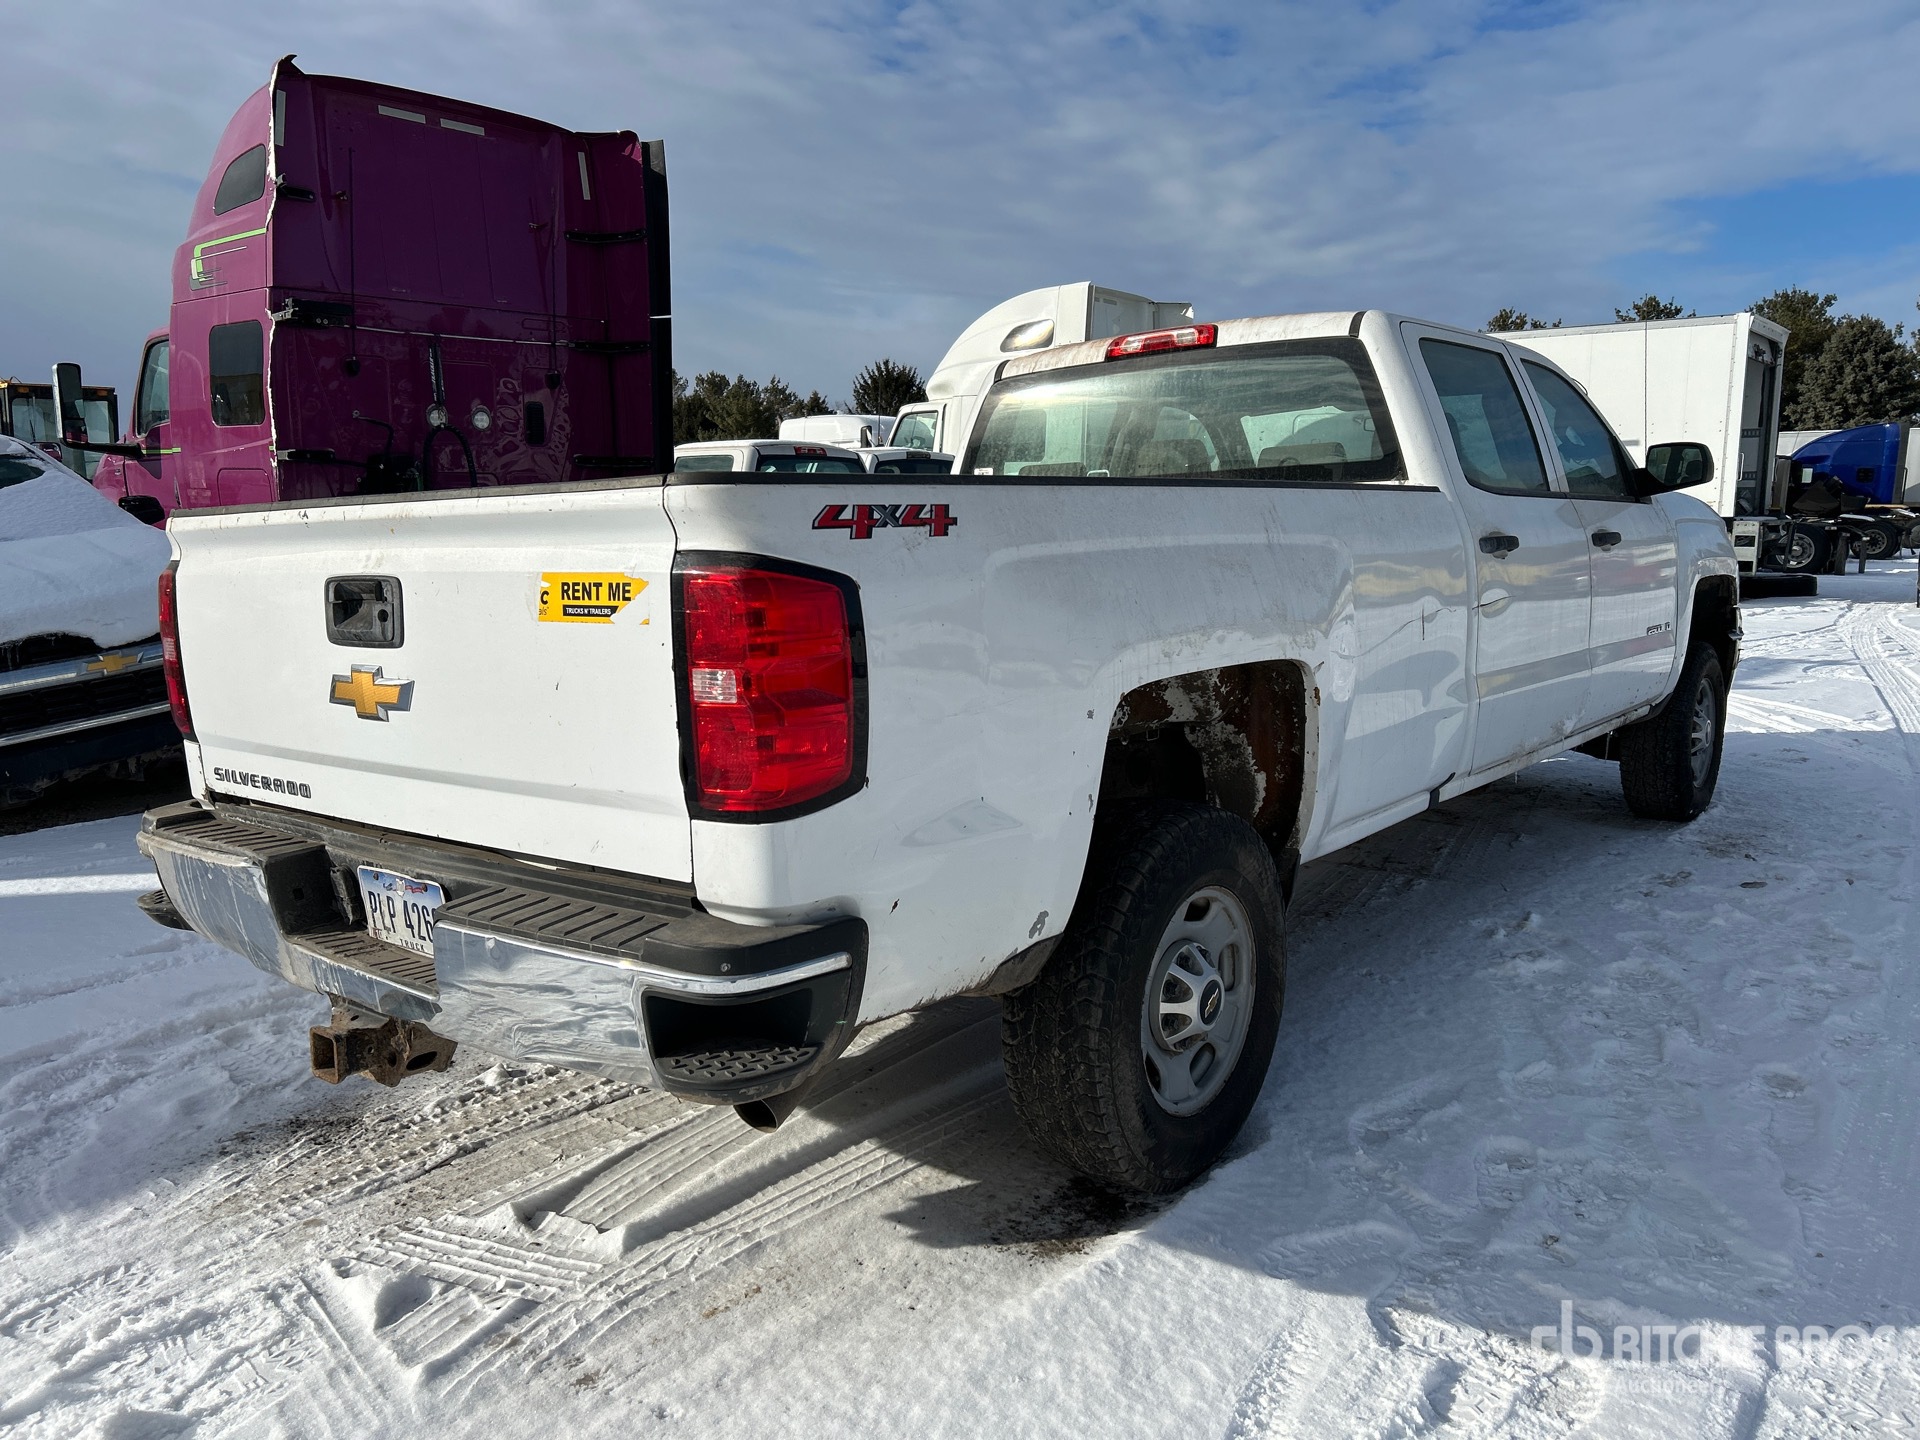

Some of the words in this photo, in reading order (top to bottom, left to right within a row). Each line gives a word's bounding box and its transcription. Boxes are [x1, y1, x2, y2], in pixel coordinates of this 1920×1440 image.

[561, 582, 603, 601] RENT
[608, 582, 632, 601] ME
[566, 607, 584, 615] TRUCKS
[589, 607, 612, 615] TRAILERS
[213, 766, 312, 799] SILVERADO
[368, 890, 397, 934] PLP
[403, 900, 437, 944] 426
[400, 938, 425, 953] TRUCK
